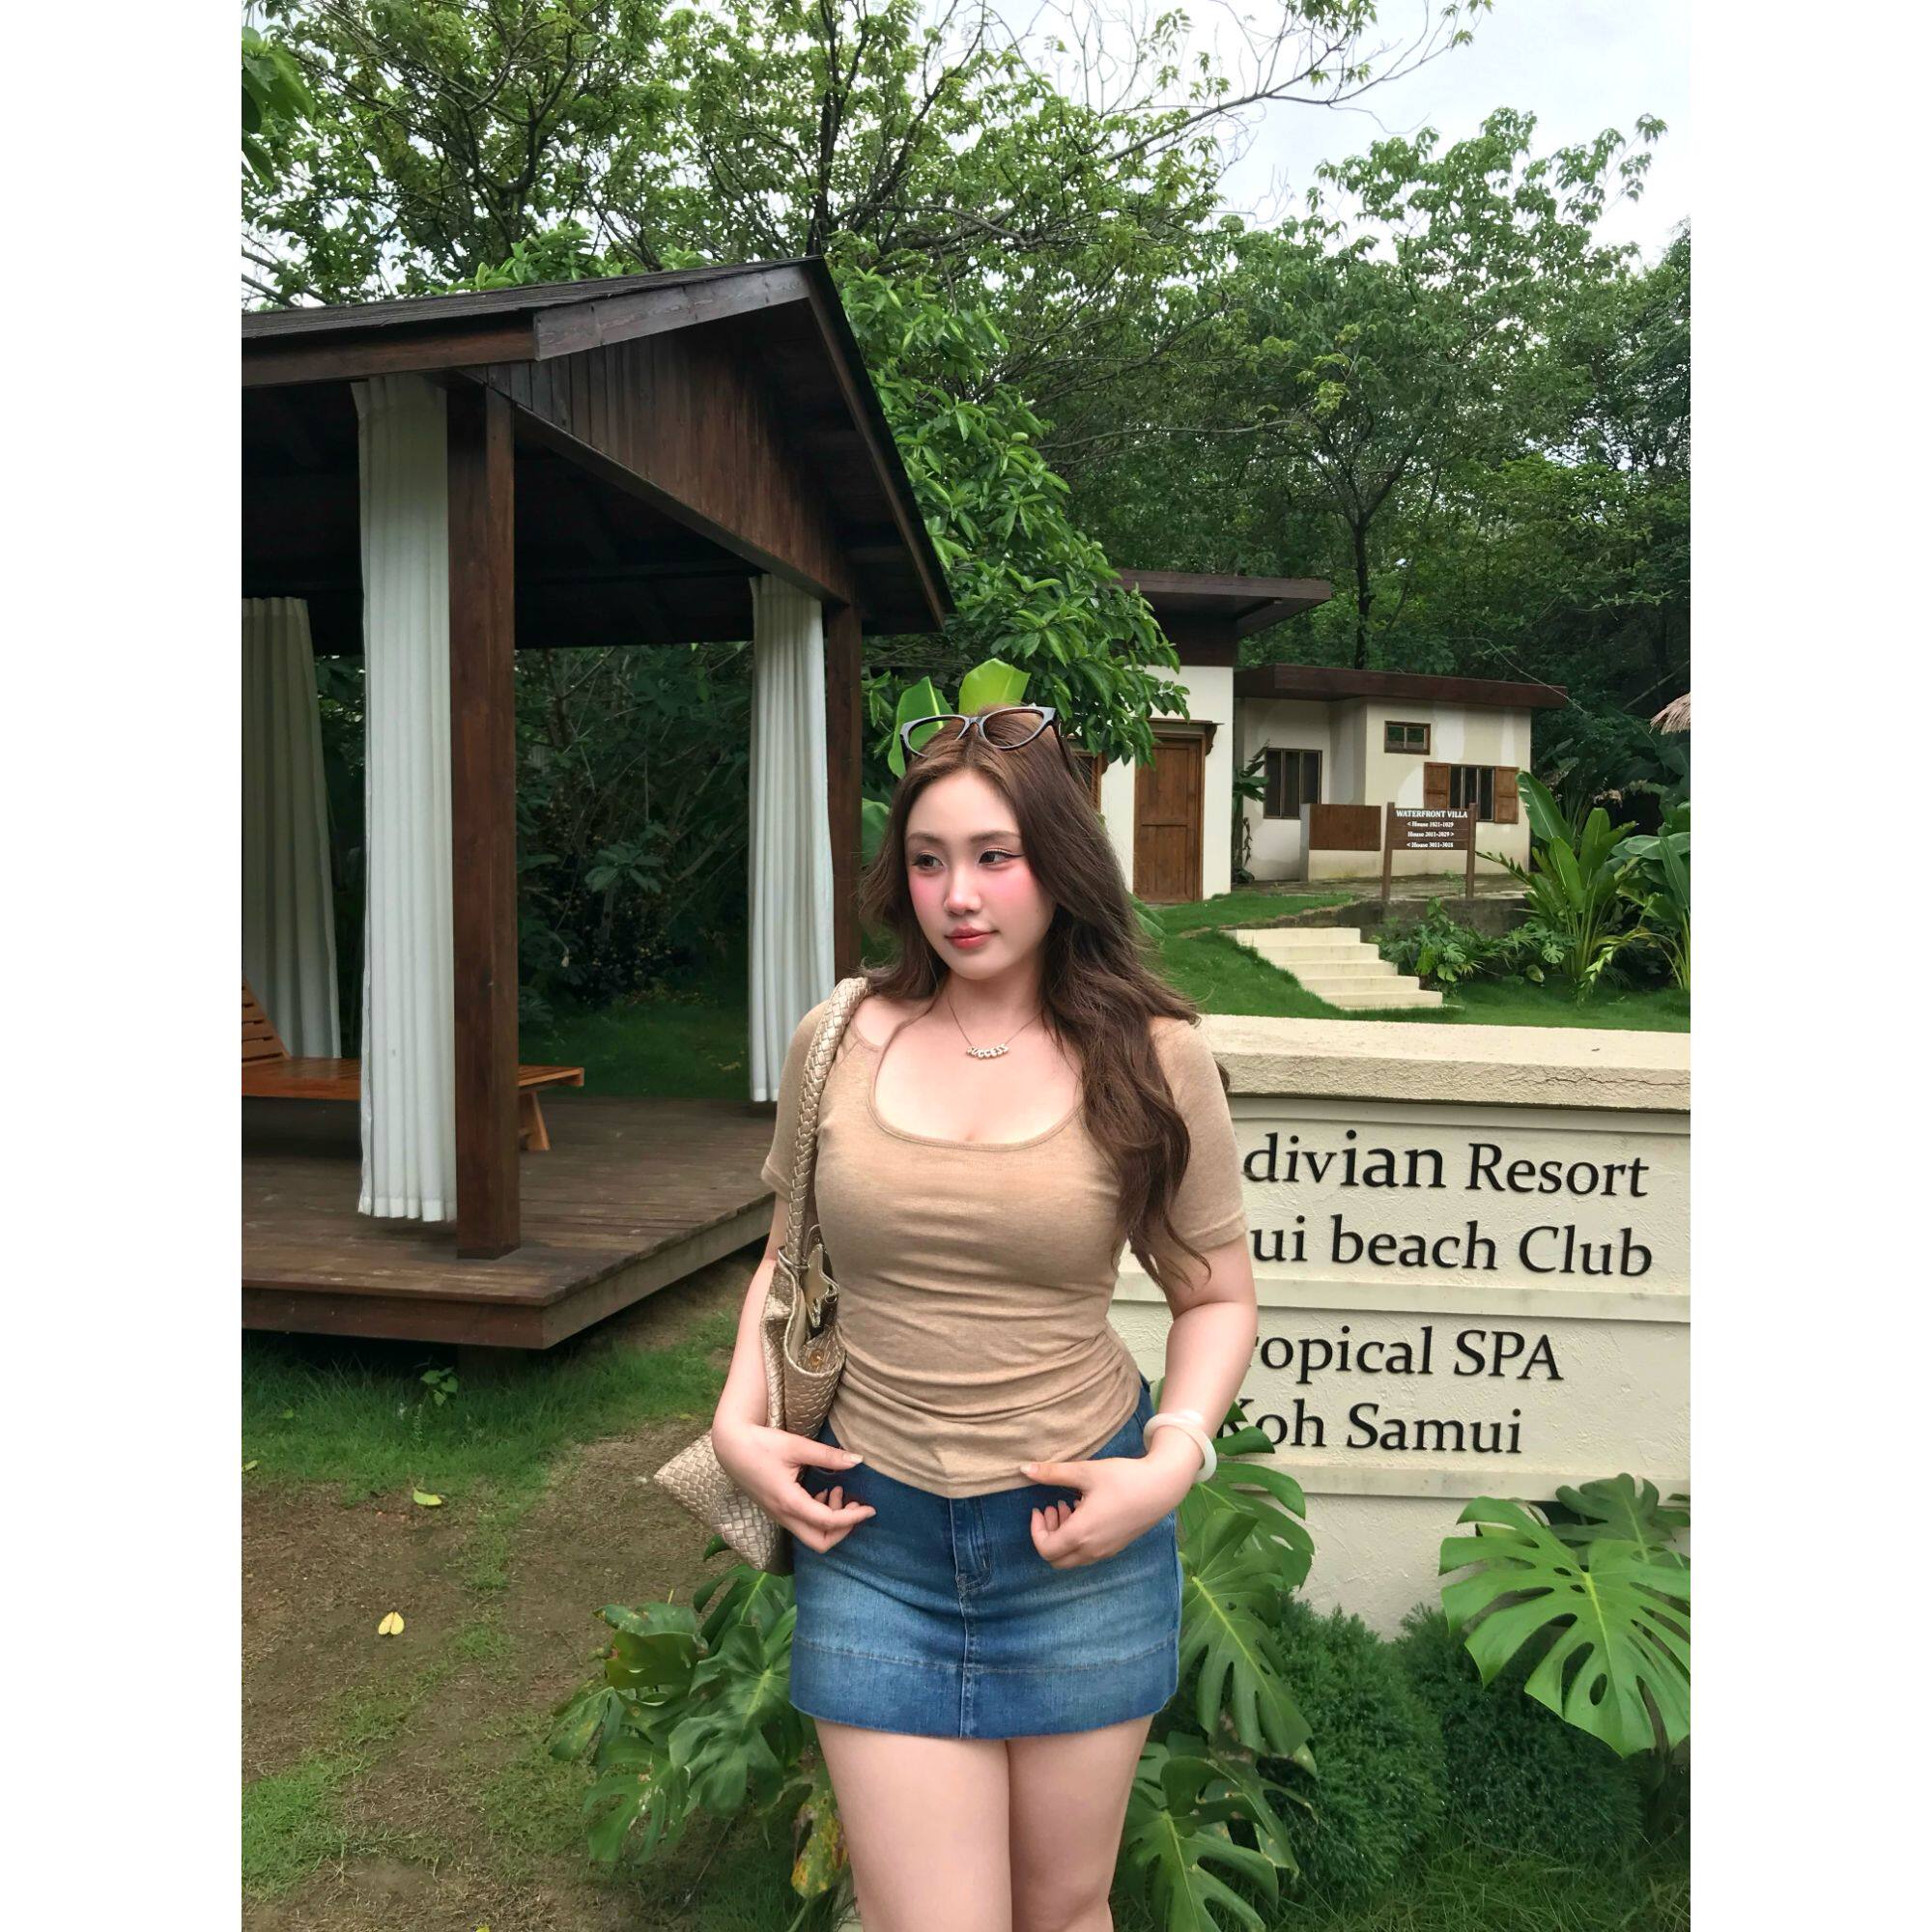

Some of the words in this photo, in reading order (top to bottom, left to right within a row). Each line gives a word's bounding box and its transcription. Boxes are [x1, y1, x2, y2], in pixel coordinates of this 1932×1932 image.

[1396, 810, 1446, 818] WATERFRONT
[1240, 1129, 1447, 1189] divian
[1464, 1142, 1650, 1198] Resort
[1330, 1213, 1498, 1270] beach
[1519, 1224, 1652, 1277] Club
[1253, 1325, 1434, 1385] opical
[1453, 1329, 1564, 1381] SPA
[1346, 1403, 1522, 1454] Samui
